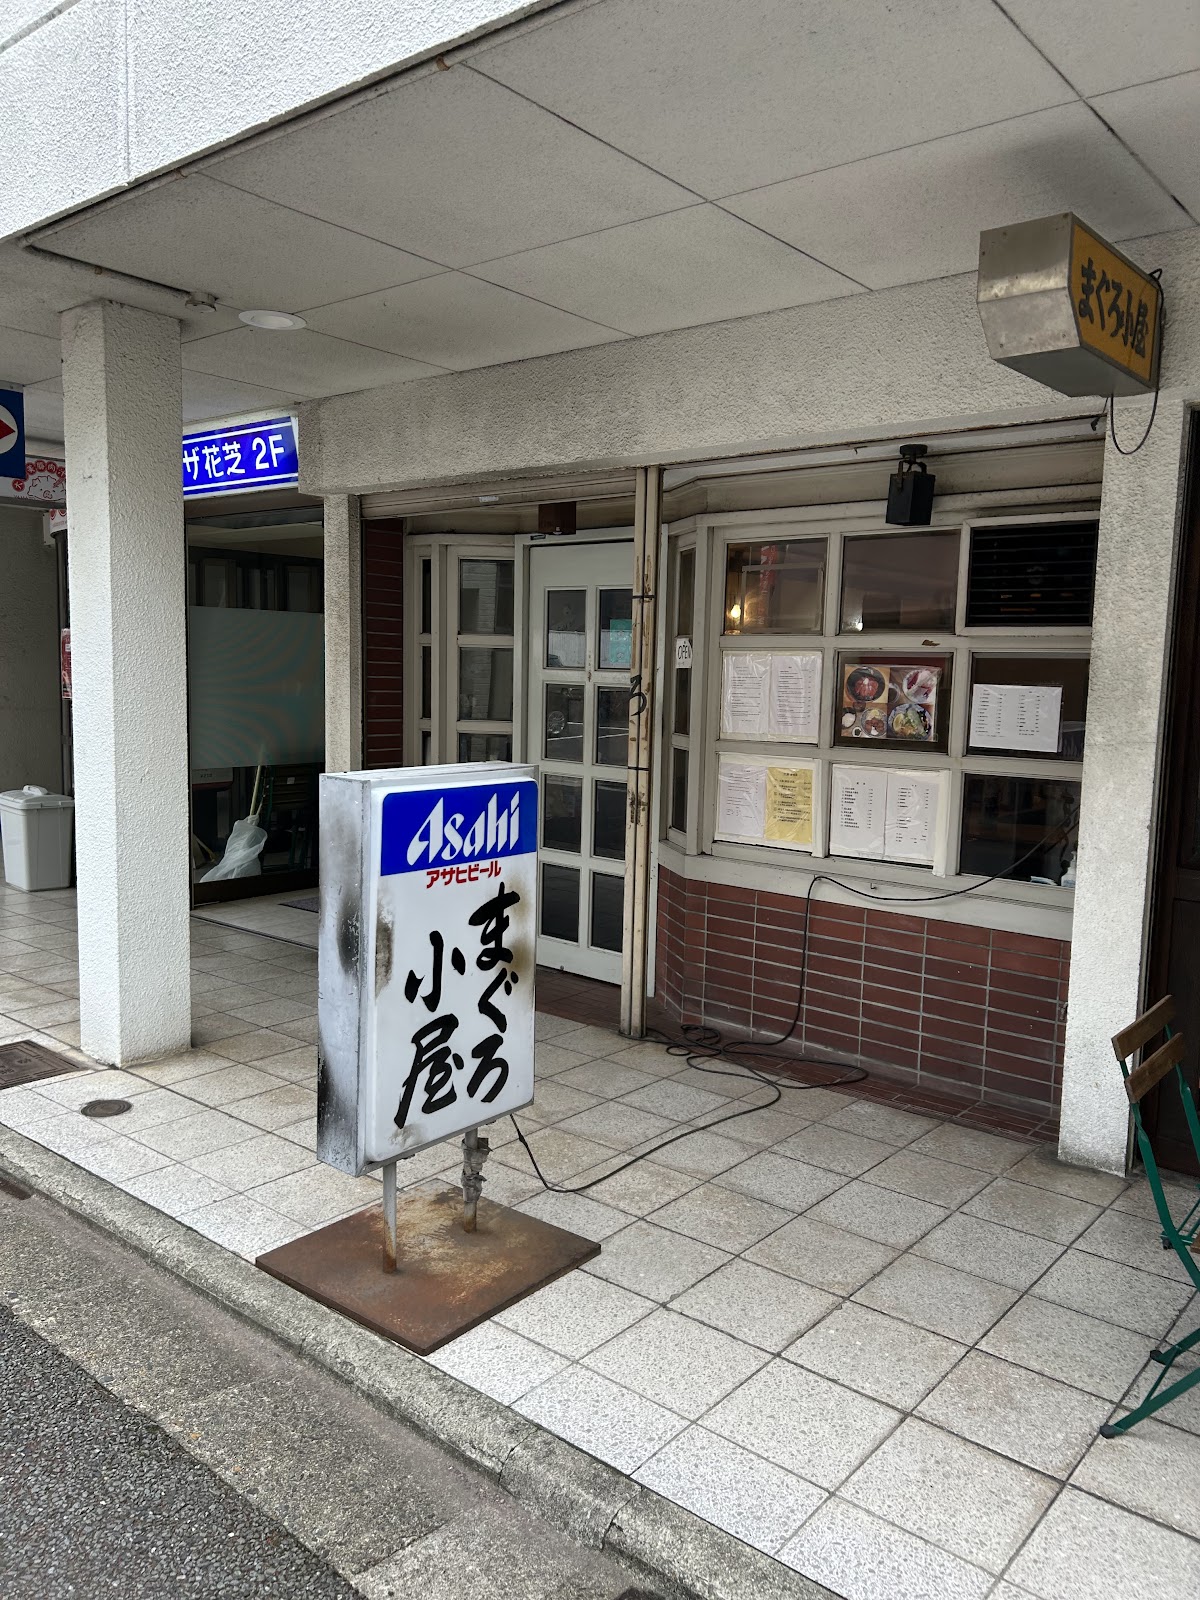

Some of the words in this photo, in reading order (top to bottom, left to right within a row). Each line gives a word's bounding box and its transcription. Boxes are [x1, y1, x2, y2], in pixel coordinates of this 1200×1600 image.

[1078, 257, 1149, 358] まぐろ小屋
[182, 441, 246, 480] ザ花芝
[252, 434, 285, 470] 2F
[407, 791, 520, 866] Asahi
[426, 860, 502, 889] アサヒビール
[394, 930, 467, 1129] 小屋
[467, 882, 521, 1103] まぐろ
